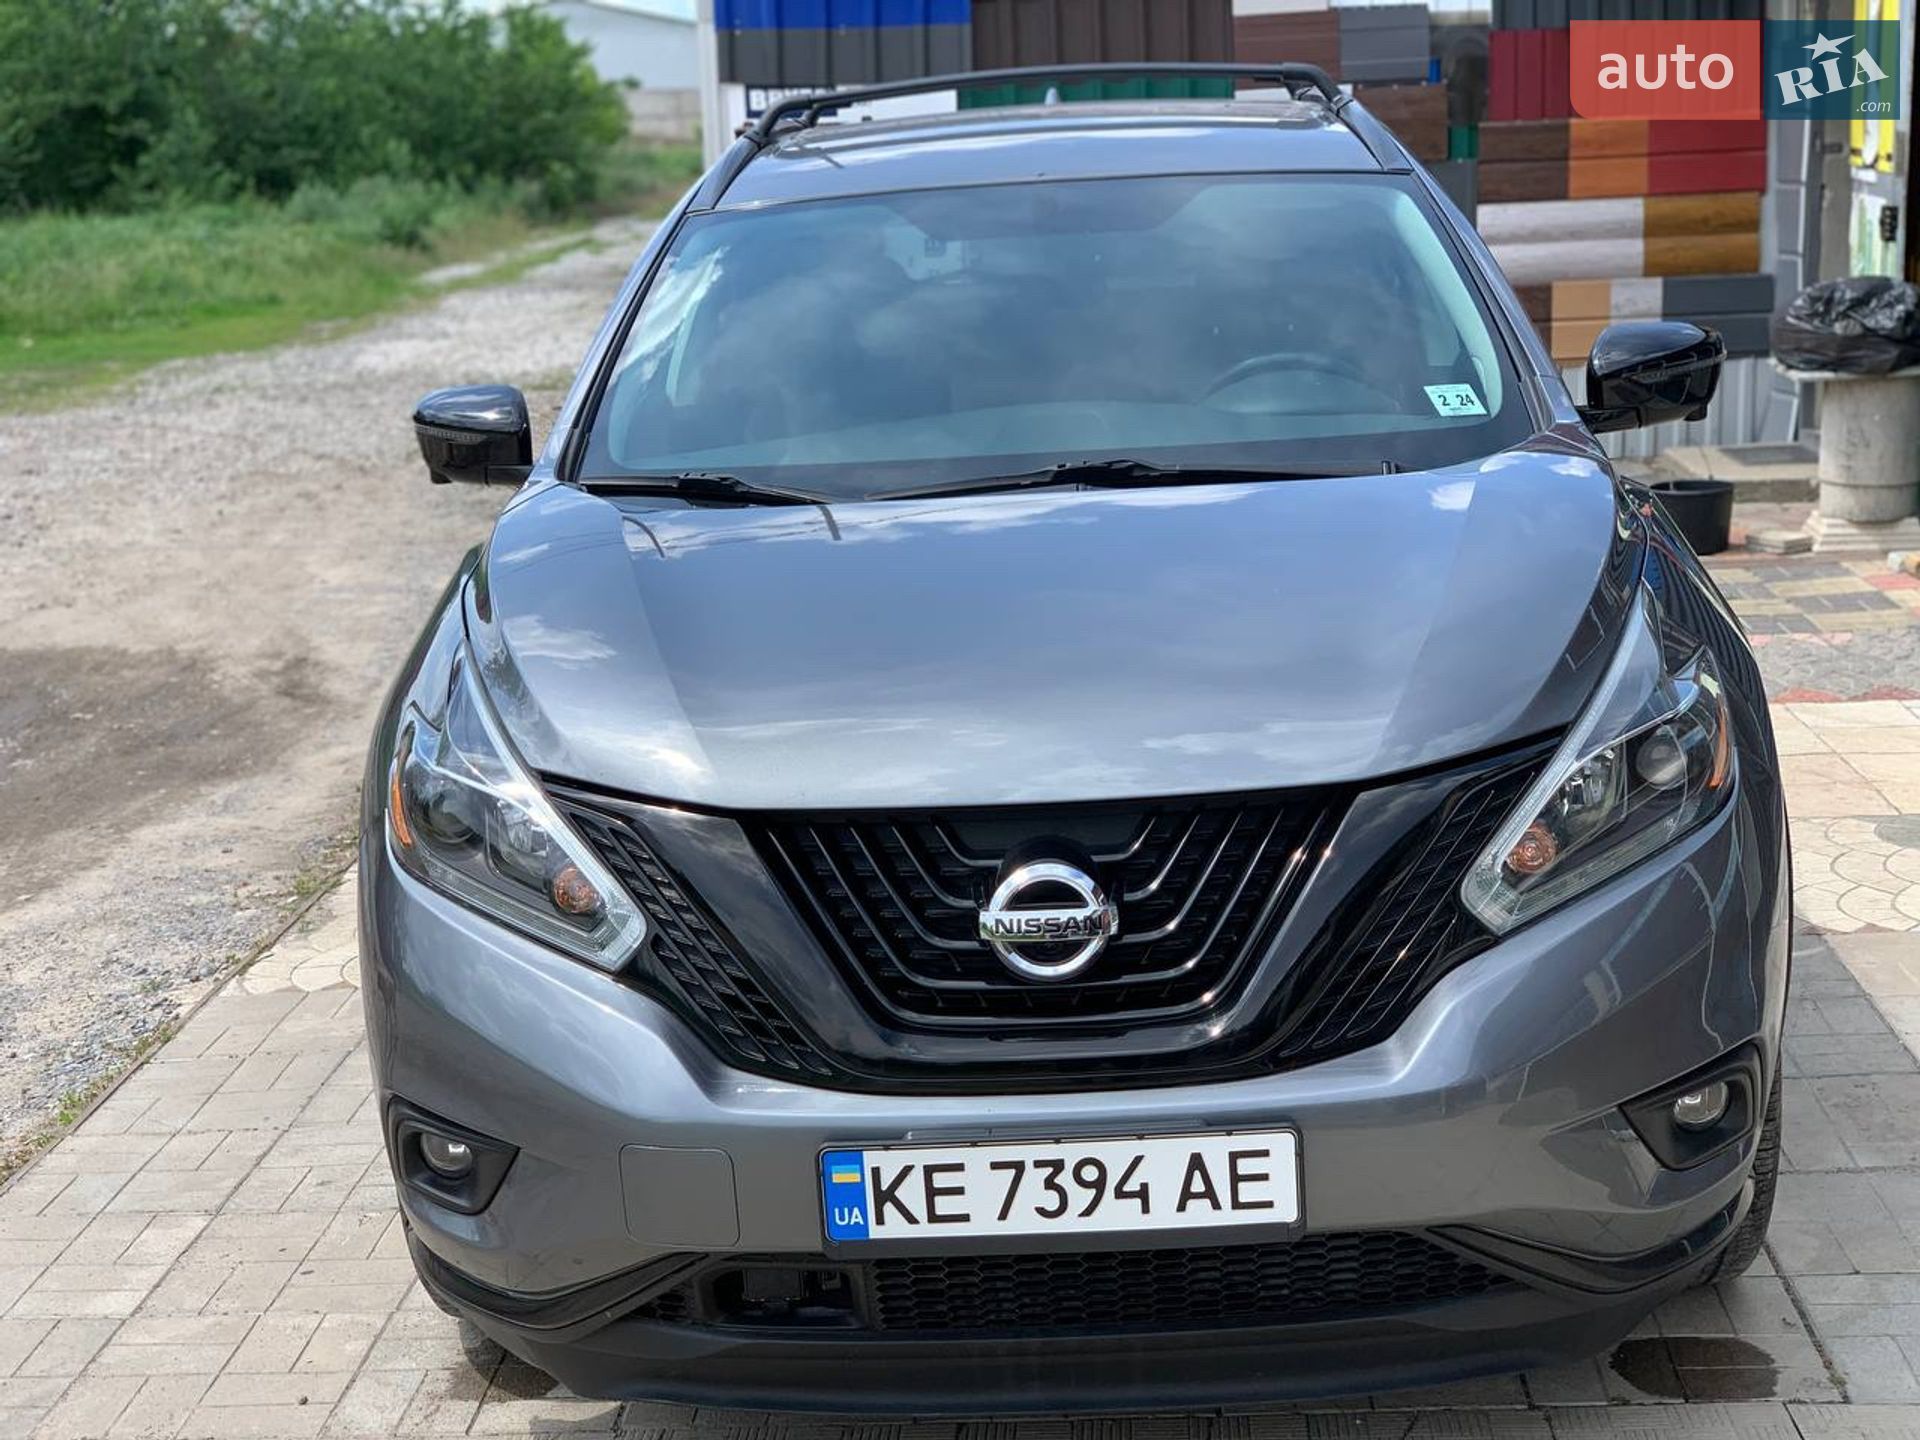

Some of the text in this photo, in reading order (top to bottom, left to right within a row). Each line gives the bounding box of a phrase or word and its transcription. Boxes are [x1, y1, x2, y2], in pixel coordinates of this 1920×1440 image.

[1438, 393, 1476, 407] 2 24
[994, 914, 1105, 935] NISSAN
[870, 1149, 1275, 1226] KE 7394 AE
[834, 1207, 865, 1226] UA
